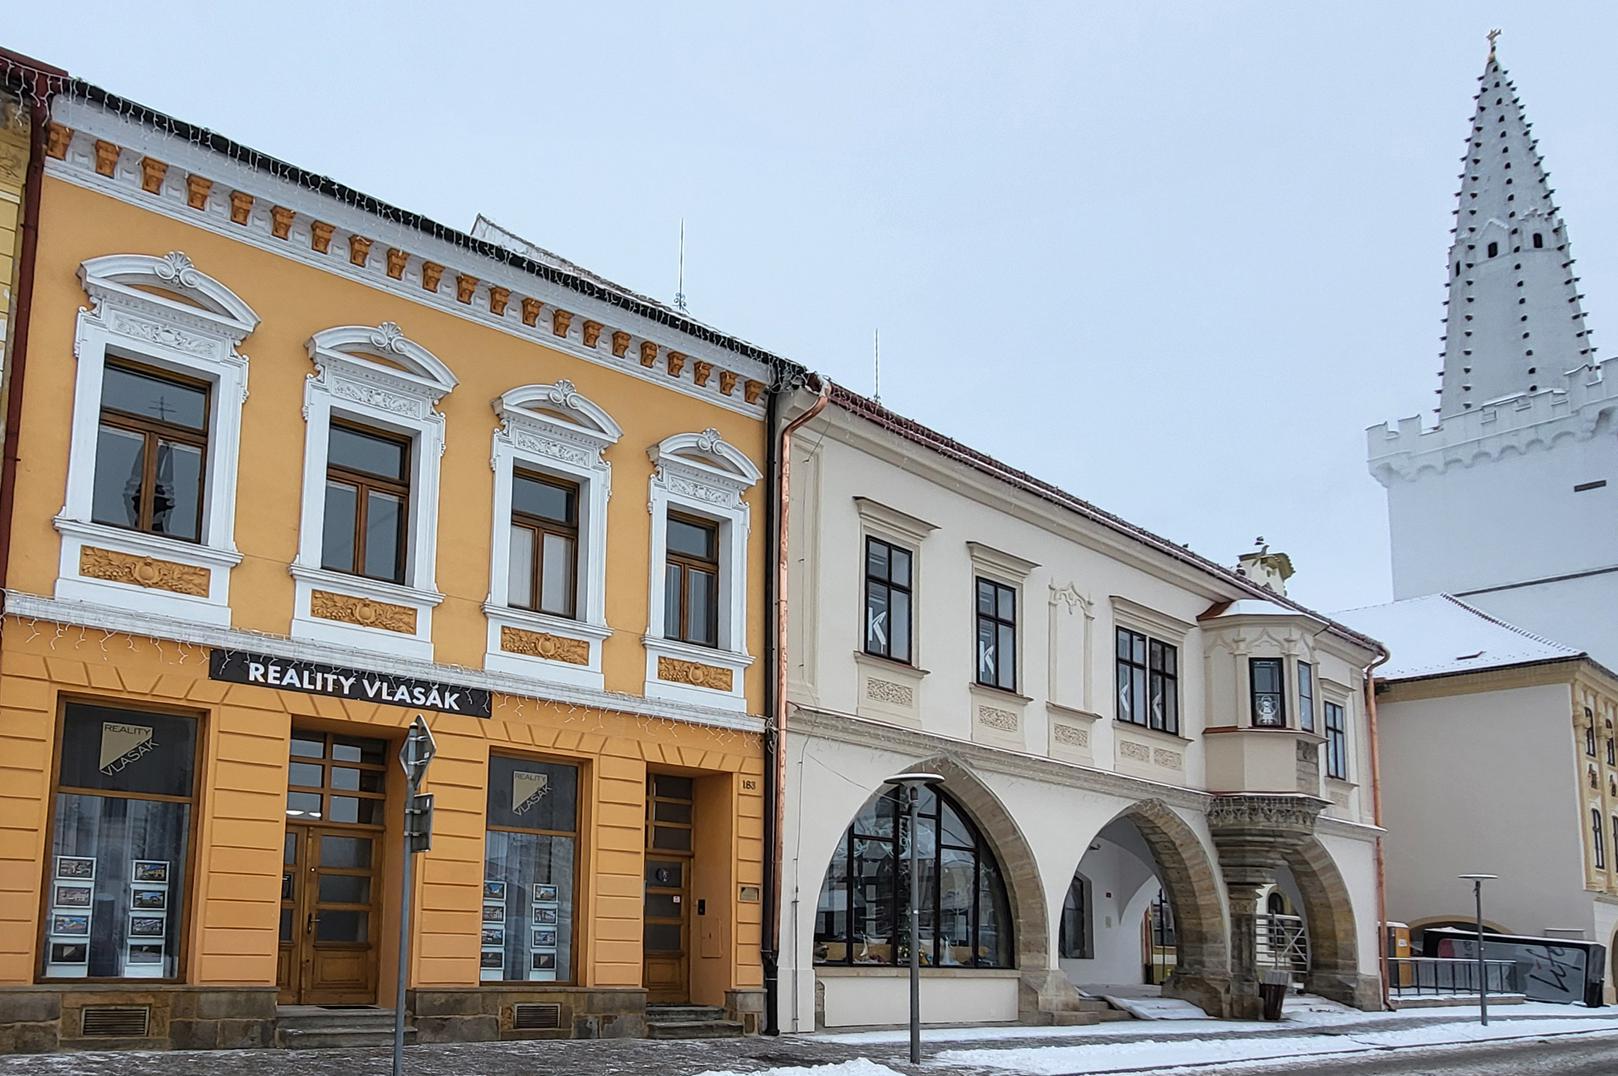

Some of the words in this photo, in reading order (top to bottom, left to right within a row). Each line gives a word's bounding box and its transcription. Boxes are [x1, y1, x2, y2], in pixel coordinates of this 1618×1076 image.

[248, 663, 356, 694] REALITY
[361, 679, 462, 711] VLASÁK
[104, 724, 151, 736] REALITY
[514, 773, 547, 782] REALITY
[742, 779, 756, 790] 183
